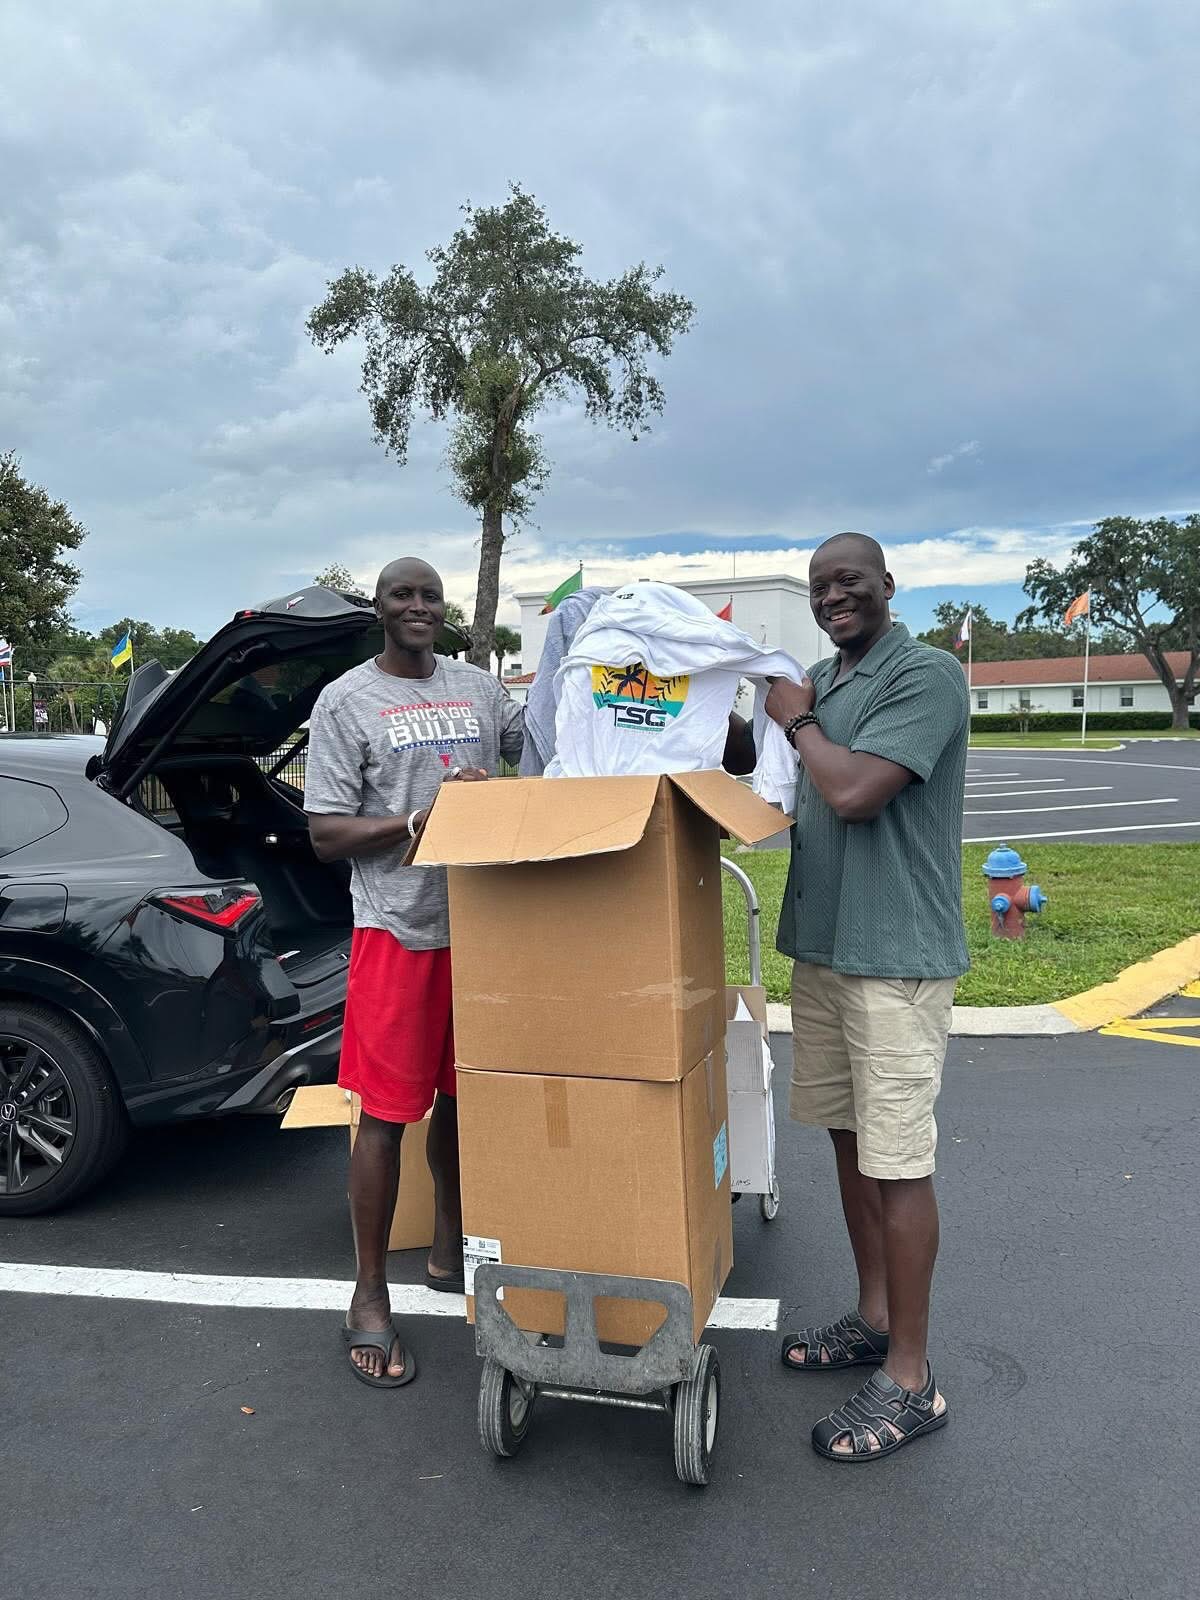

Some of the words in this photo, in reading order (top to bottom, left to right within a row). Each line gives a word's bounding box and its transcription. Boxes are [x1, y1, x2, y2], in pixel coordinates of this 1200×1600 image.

[390, 707, 472, 726] CHICAGO
[608, 704, 667, 727] TSG
[387, 718, 480, 748] BULLS
